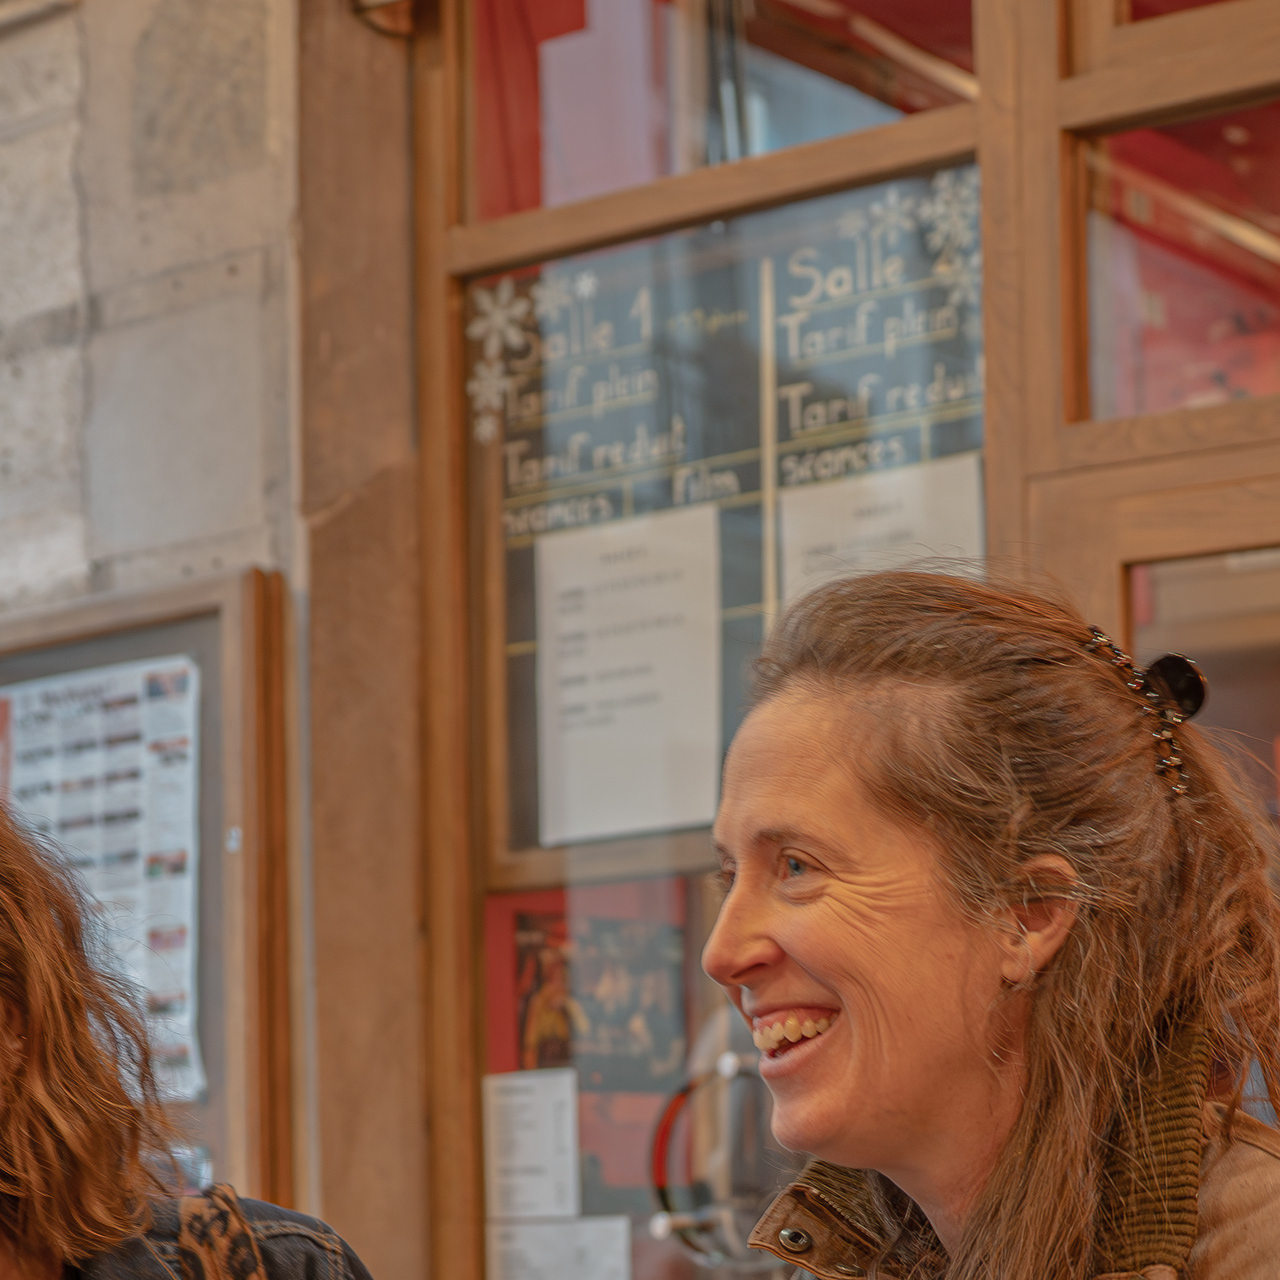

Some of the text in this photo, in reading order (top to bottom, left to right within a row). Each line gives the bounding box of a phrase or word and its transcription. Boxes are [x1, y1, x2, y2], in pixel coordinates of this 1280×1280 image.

[785, 230, 904, 309] Salle
[778, 299, 878, 364] Tarif
[778, 372, 882, 434] Tarif
